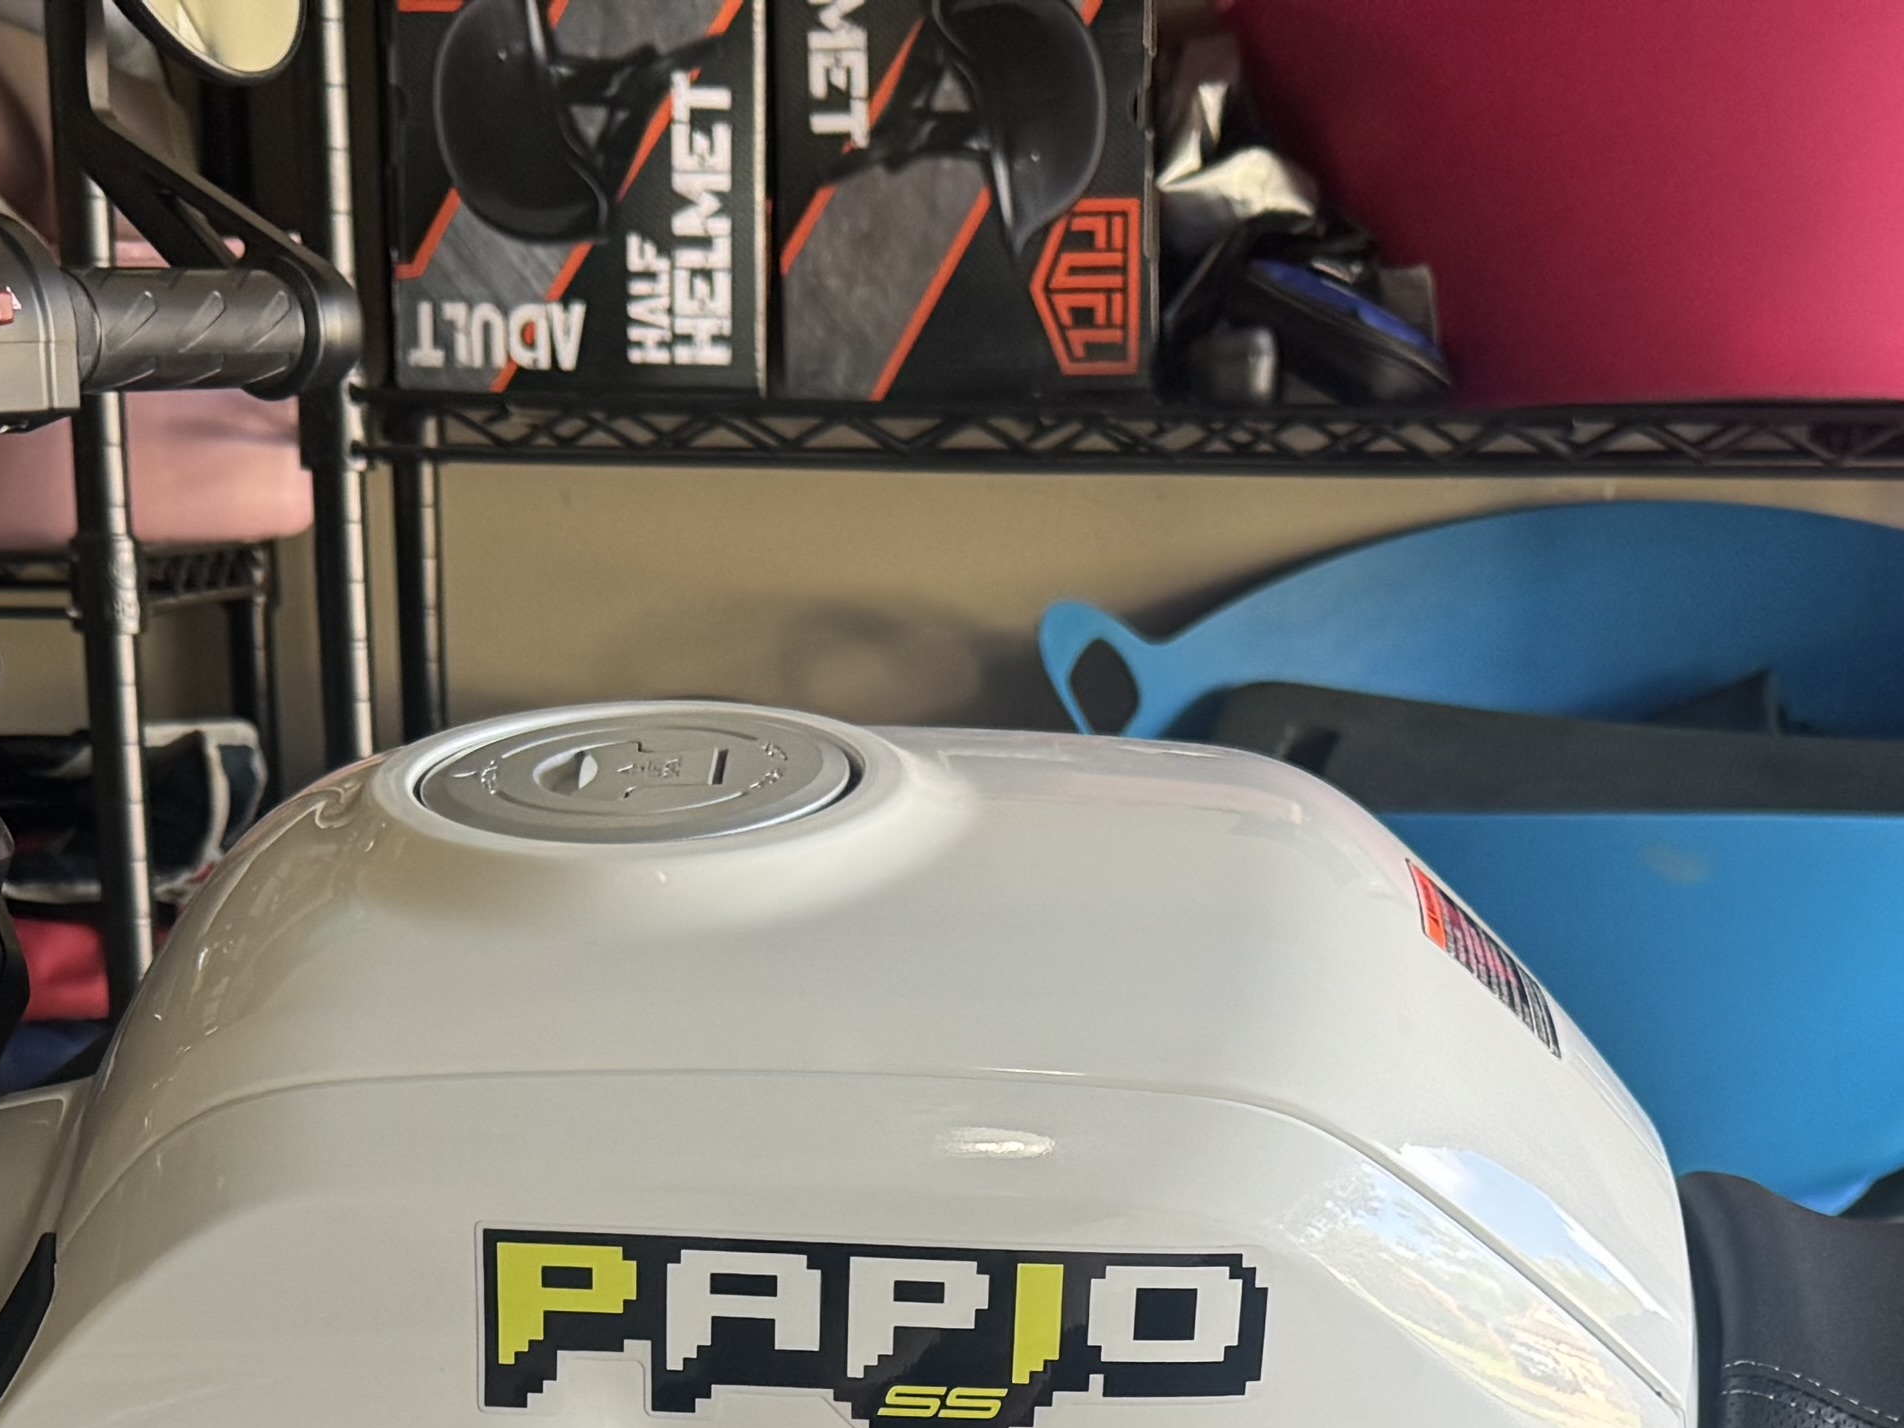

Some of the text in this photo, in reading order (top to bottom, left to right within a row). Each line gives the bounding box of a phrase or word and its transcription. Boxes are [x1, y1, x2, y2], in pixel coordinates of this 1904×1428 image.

[670, 70, 733, 366] HELMET
[1049, 213, 1125, 360] FUEL
[408, 300, 587, 372] ADULT
[626, 232, 672, 366] HALF
[495, 1240, 1243, 1385] PAPIO
[876, 1386, 1009, 1419] SS
